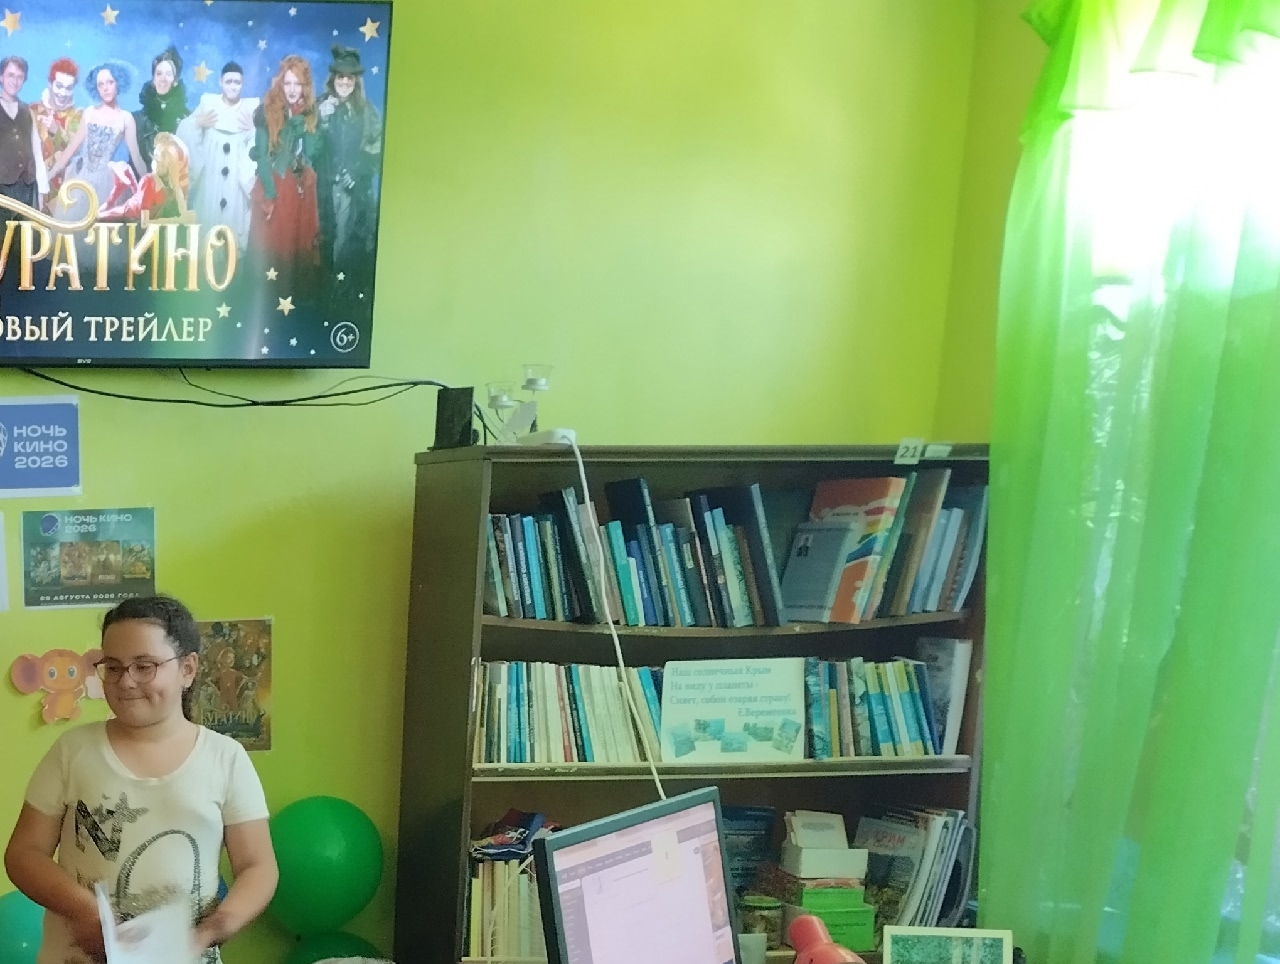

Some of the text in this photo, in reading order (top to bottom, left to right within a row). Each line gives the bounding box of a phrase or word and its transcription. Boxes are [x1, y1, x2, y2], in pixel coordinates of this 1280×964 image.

[83, 311, 213, 342] ТРЕЙЛЕР
[335, 329, 357, 345] 6+
[13, 424, 68, 438] НОЧЬ
[13, 439, 68, 453] КИНО
[900, 445, 918, 458] 21
[14, 454, 69, 469] 2026
[64, 513, 133, 524] НОЧЬ КИНО
[64, 524, 97, 534] 2026
[670, 665, 772, 677] Наш солнечный Крым
[670, 681, 683, 691] На
[685, 682, 707, 691] виду
[708, 682, 714, 692] у
[715, 681, 754, 690] планеты
